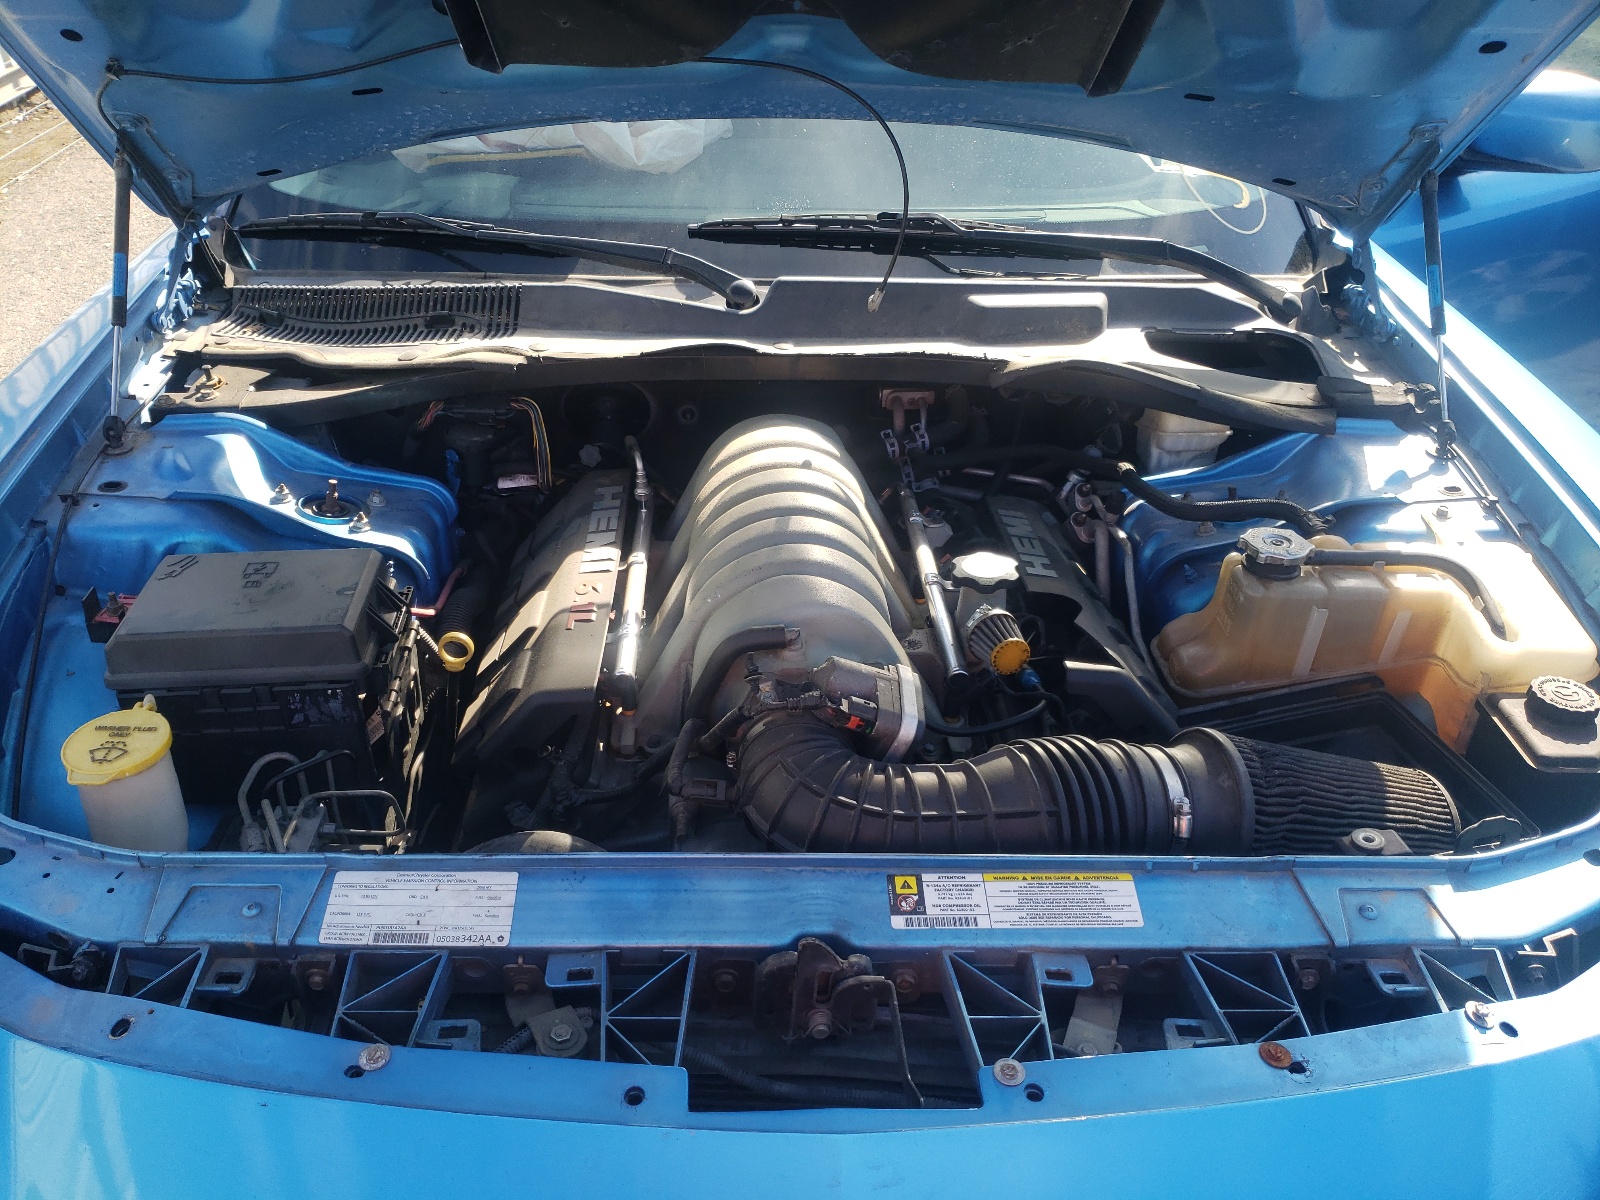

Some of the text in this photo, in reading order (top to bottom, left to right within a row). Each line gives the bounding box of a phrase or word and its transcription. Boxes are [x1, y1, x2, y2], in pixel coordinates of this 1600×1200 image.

[578, 484, 624, 575] HEMI
[997, 508, 1058, 578] HEMI
[436, 934, 492, 943] 05038342AA
